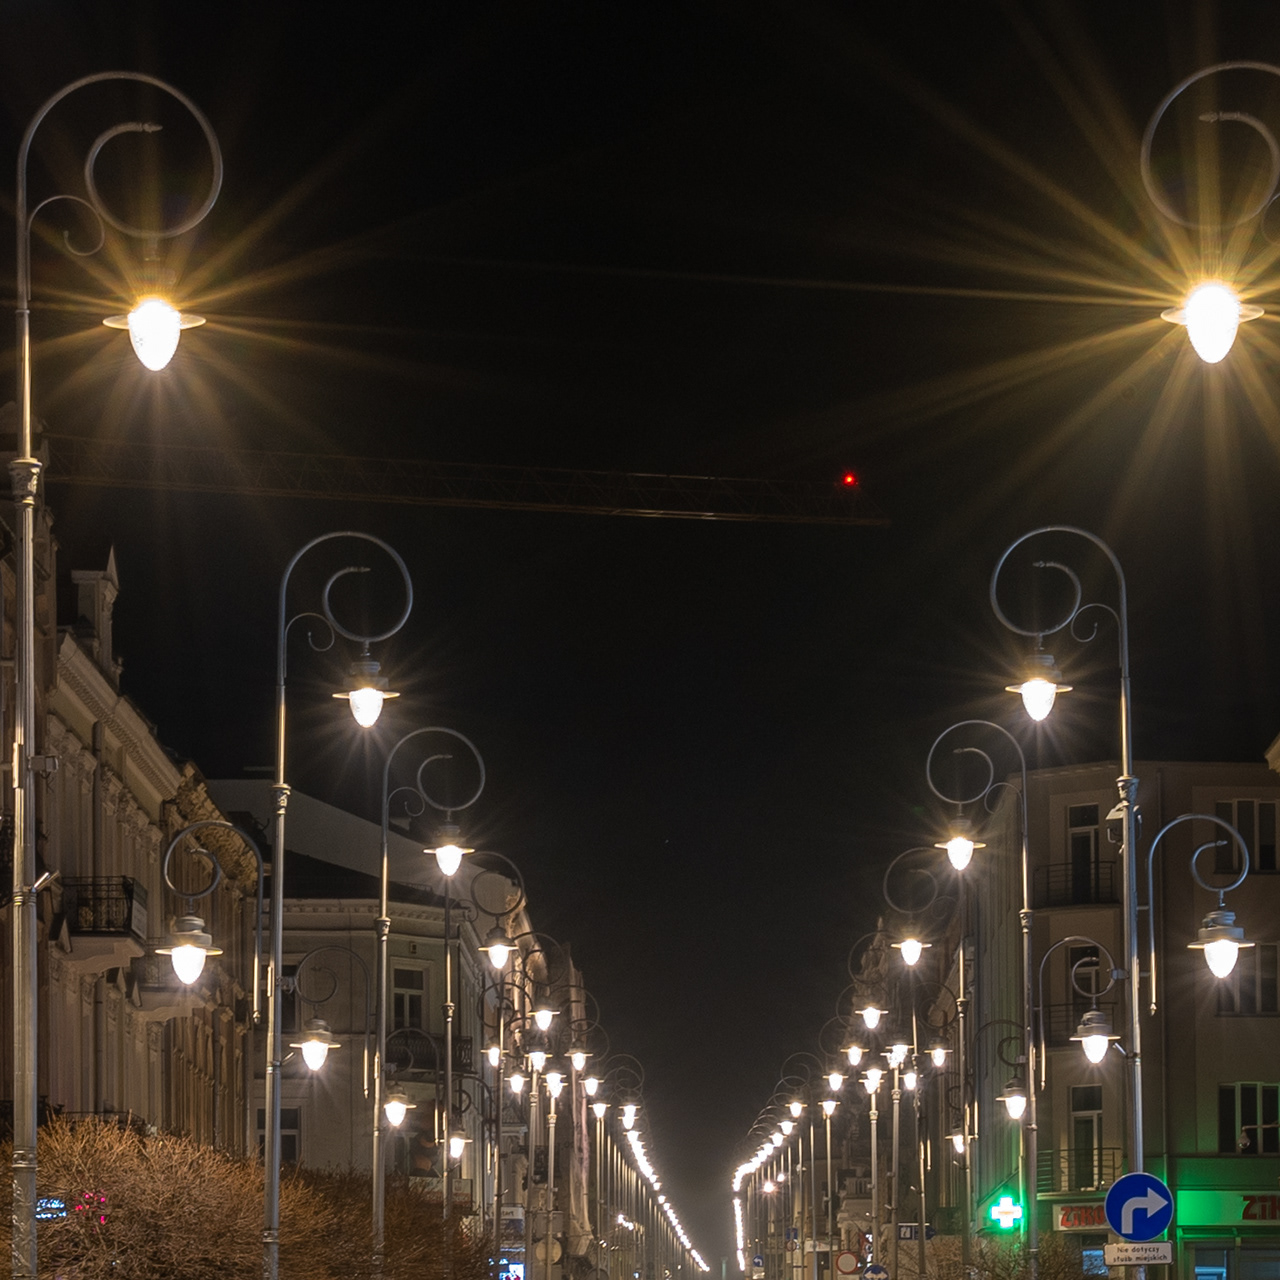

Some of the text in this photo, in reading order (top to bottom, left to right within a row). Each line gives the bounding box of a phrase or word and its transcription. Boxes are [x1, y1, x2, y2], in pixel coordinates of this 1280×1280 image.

[1116, 1245, 1161, 1256] Nie dotyczy
[1135, 1253, 1168, 1263] miejskich
